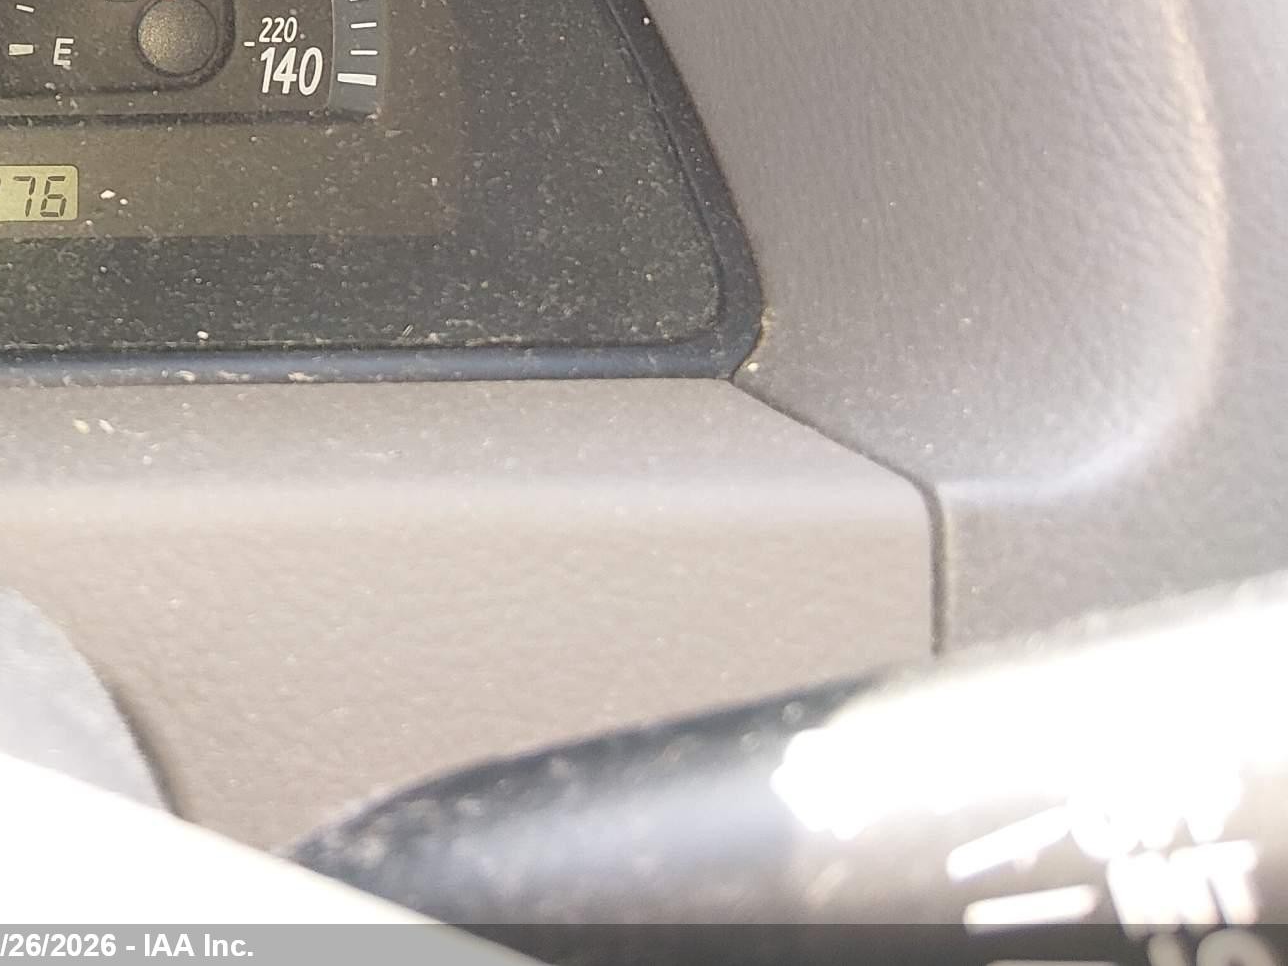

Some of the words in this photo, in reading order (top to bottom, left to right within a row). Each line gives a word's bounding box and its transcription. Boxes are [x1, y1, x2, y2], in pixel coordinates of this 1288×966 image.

[258, 17, 298, 43] 220
[53, 38, 74, 66] E
[260, 46, 322, 96] 140
